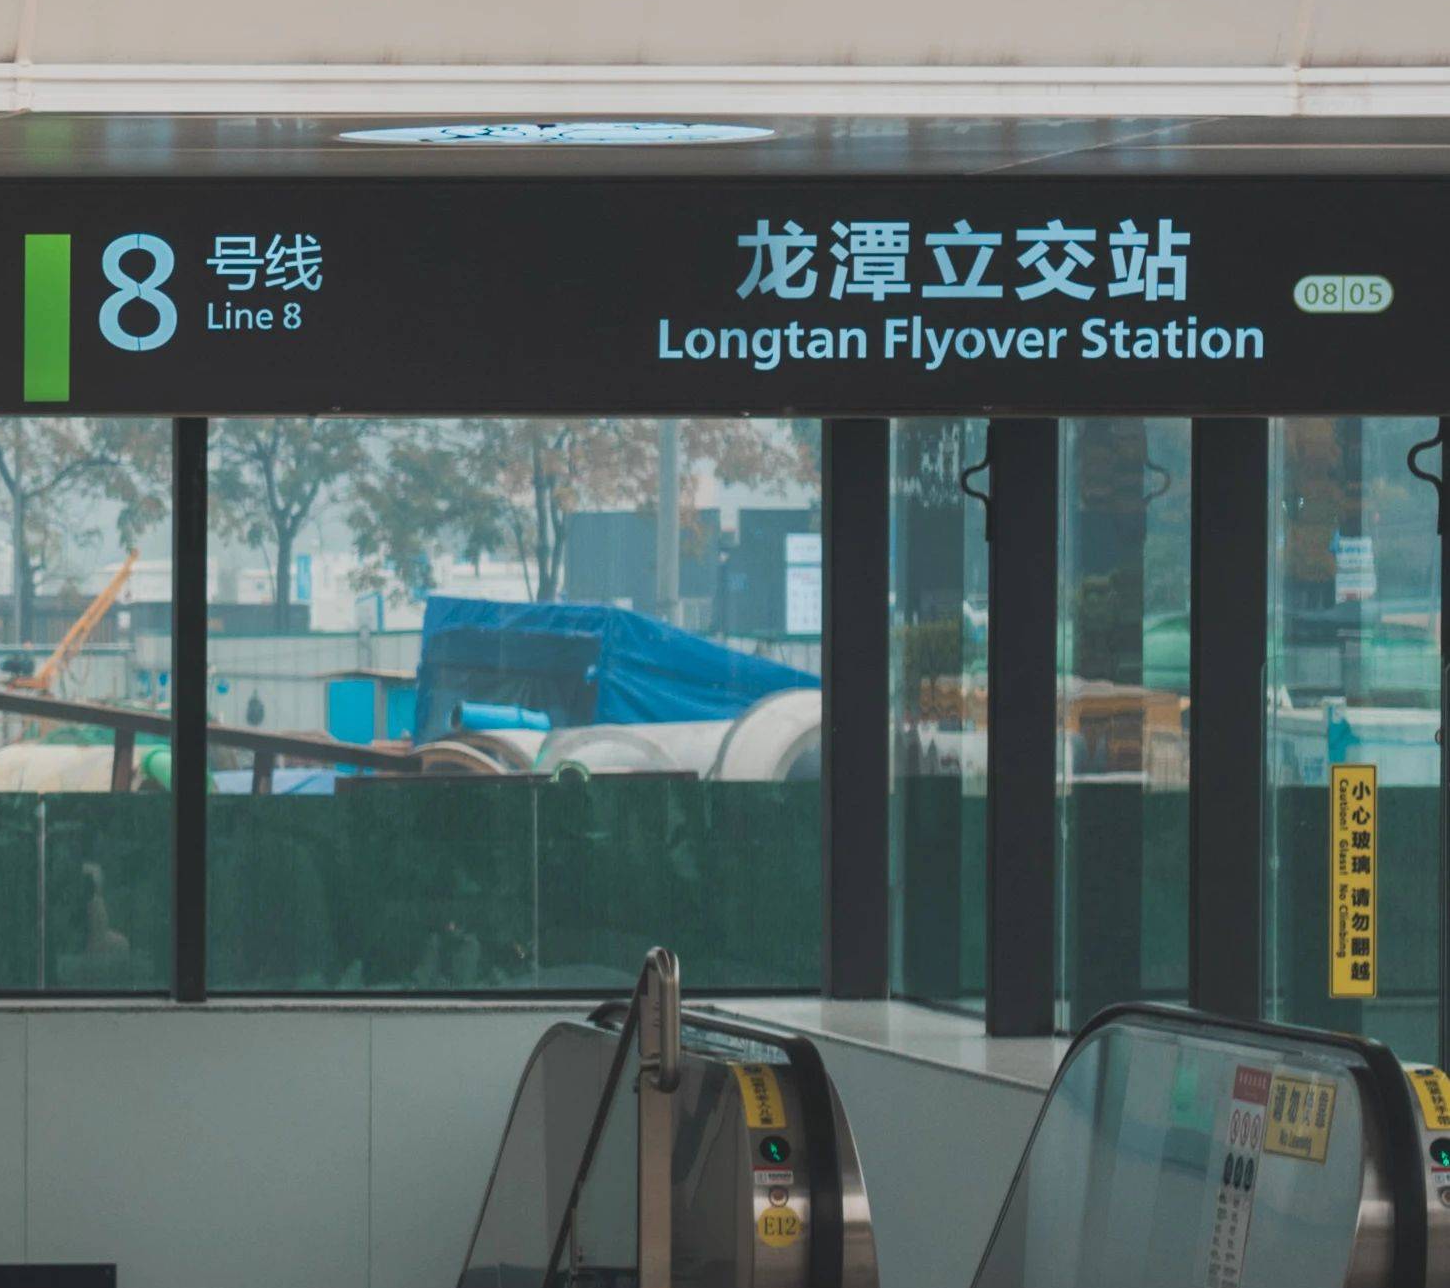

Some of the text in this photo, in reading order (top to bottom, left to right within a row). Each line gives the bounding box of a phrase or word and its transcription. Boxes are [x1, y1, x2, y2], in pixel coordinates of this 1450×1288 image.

[206, 233, 324, 291] 号线
[736, 219, 1191, 302] 龙潭立交站
[99, 233, 178, 351] 8
[207, 302, 302, 330] Line 8
[659, 315, 1265, 370] Longtan Flyover Station
[1350, 780, 1372, 982] 小心玻璃 请勿翻越
[763, 1216, 797, 1236] E12
